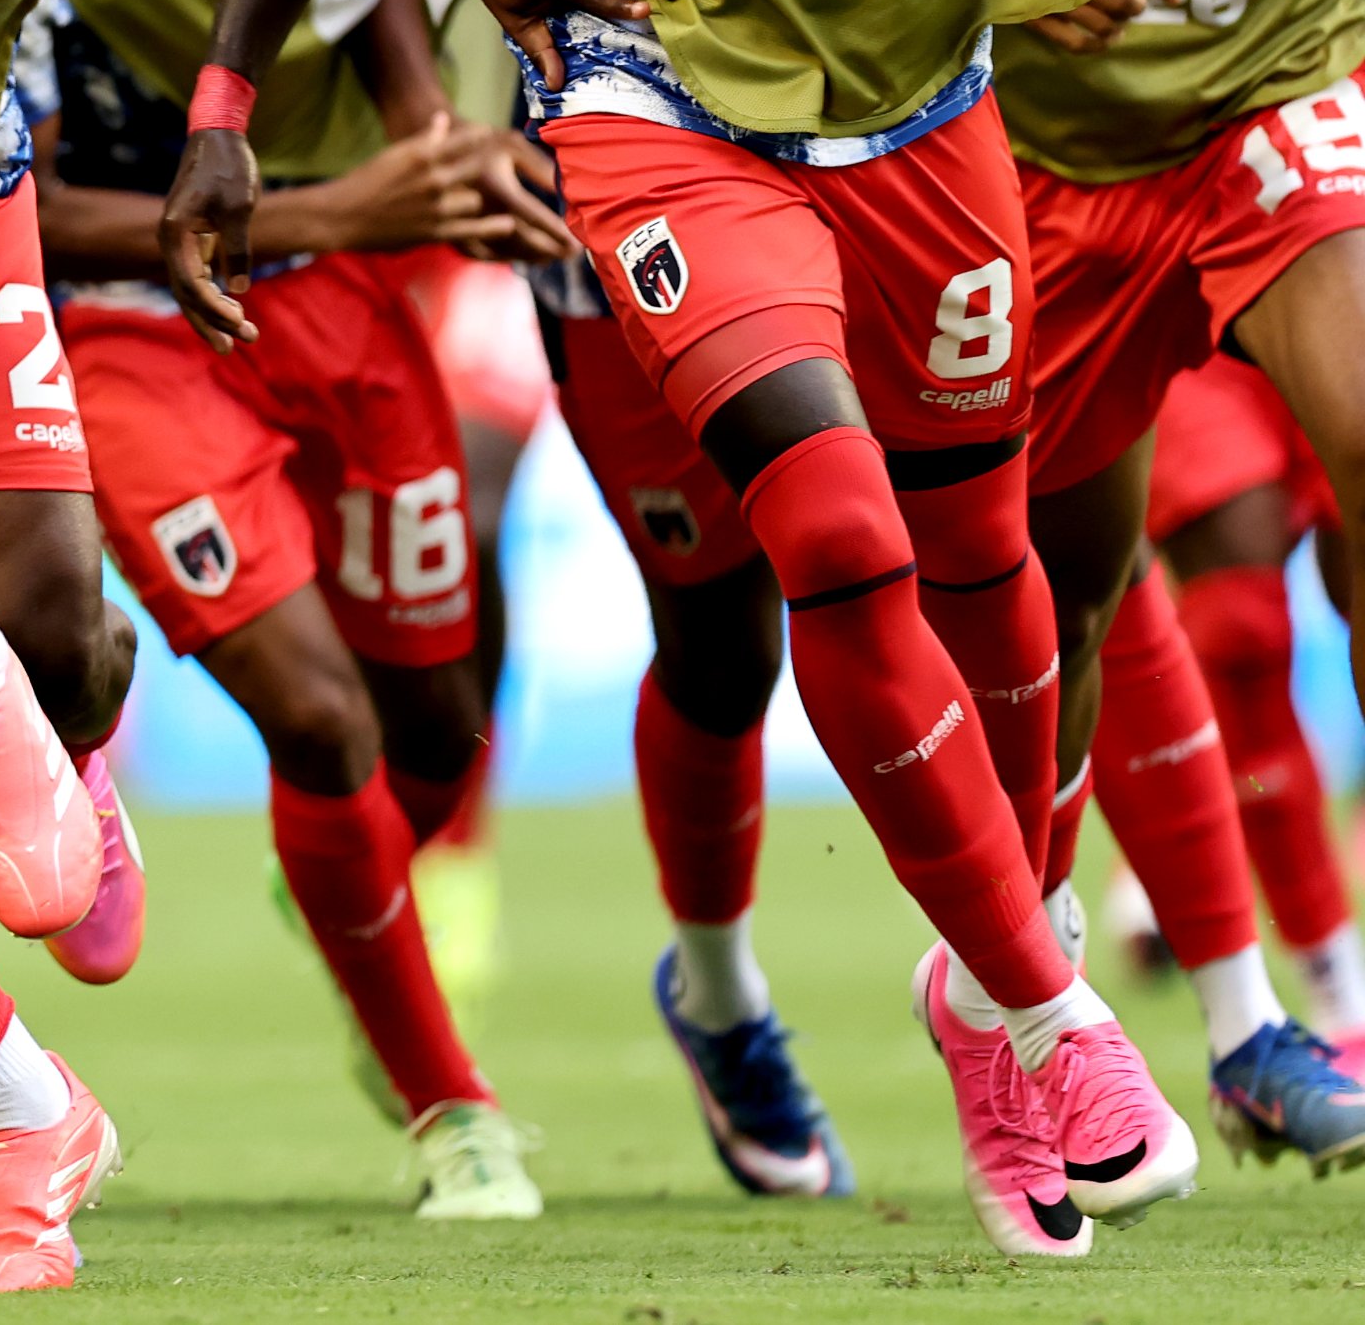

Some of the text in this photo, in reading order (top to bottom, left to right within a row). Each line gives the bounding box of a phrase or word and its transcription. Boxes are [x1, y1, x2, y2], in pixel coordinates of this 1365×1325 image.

[621, 219, 663, 262] FCF
[926, 256, 1014, 379] 8
[919, 376, 1013, 410] capelli
[14, 419, 87, 449] capel
[334, 465, 467, 602] 16
